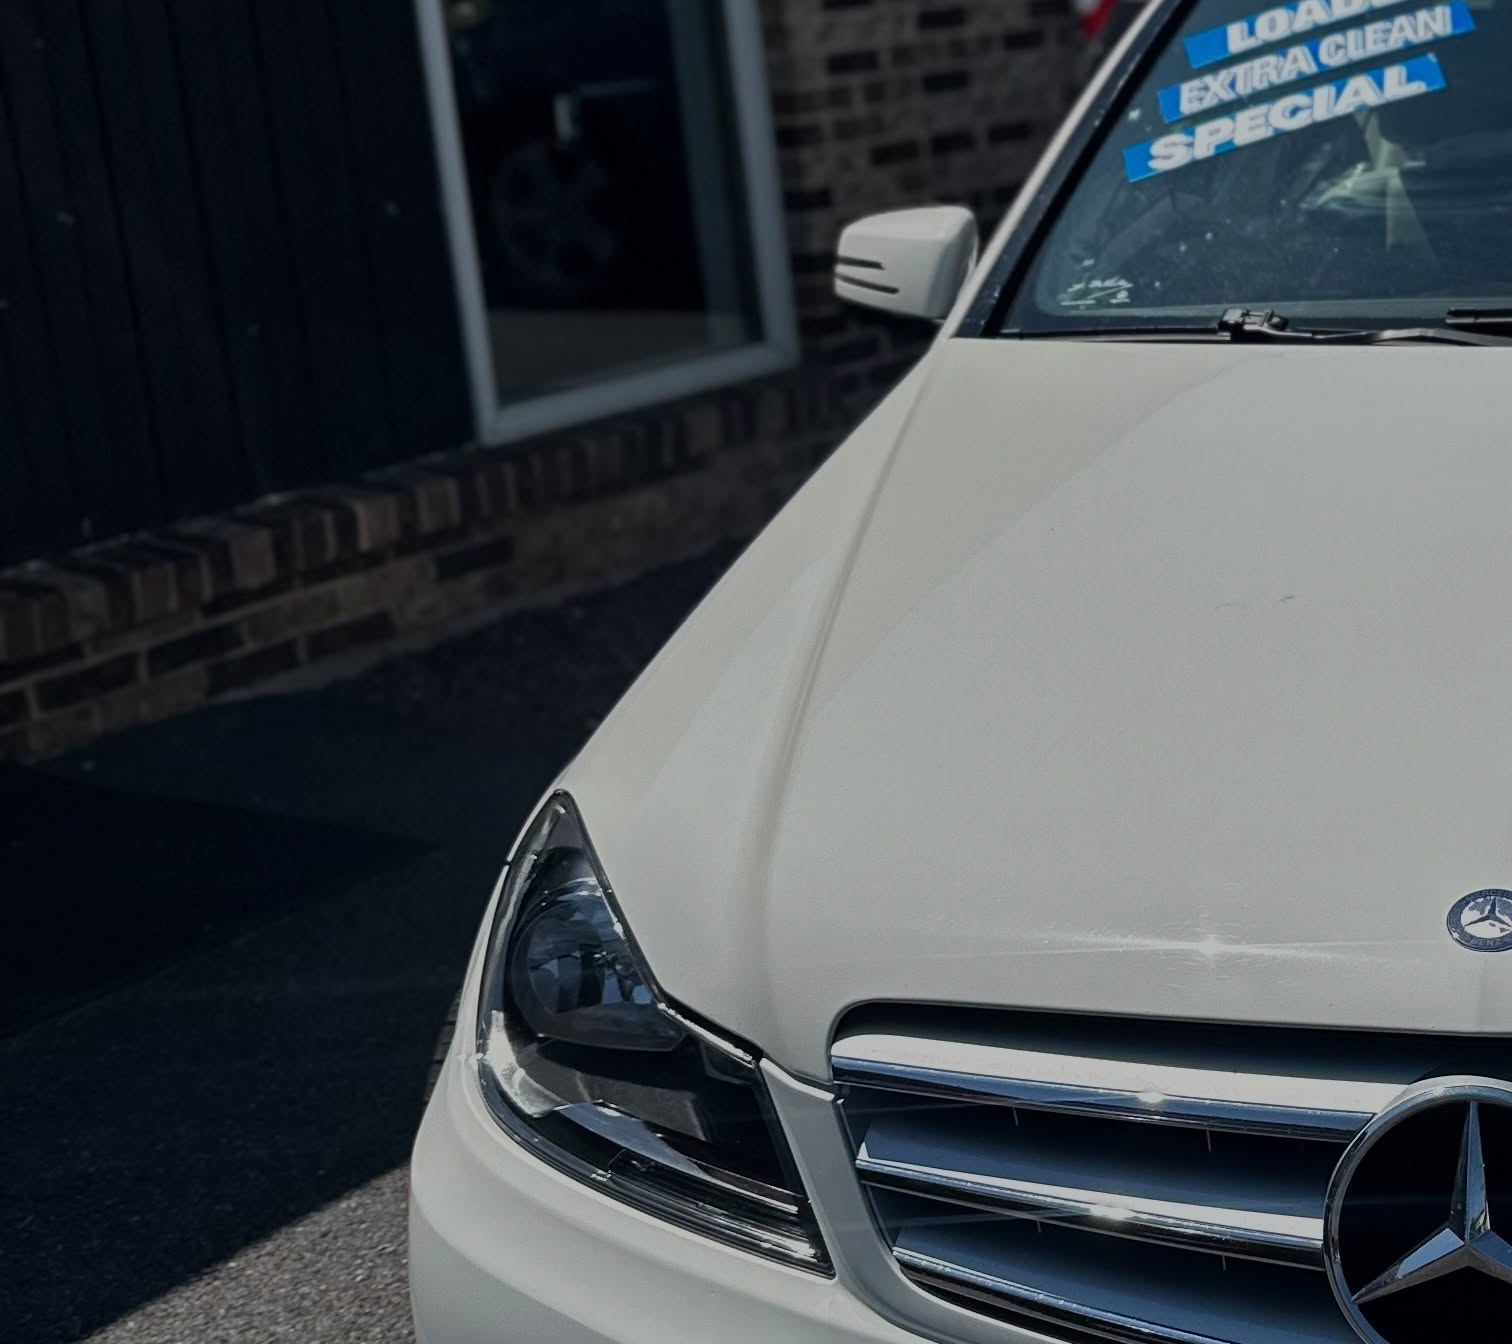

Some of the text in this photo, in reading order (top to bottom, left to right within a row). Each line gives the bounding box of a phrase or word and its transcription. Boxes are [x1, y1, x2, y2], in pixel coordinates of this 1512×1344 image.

[1178, 5, 1453, 117] EXTRA CLEAN
[1146, 62, 1428, 173] SPECIAL
